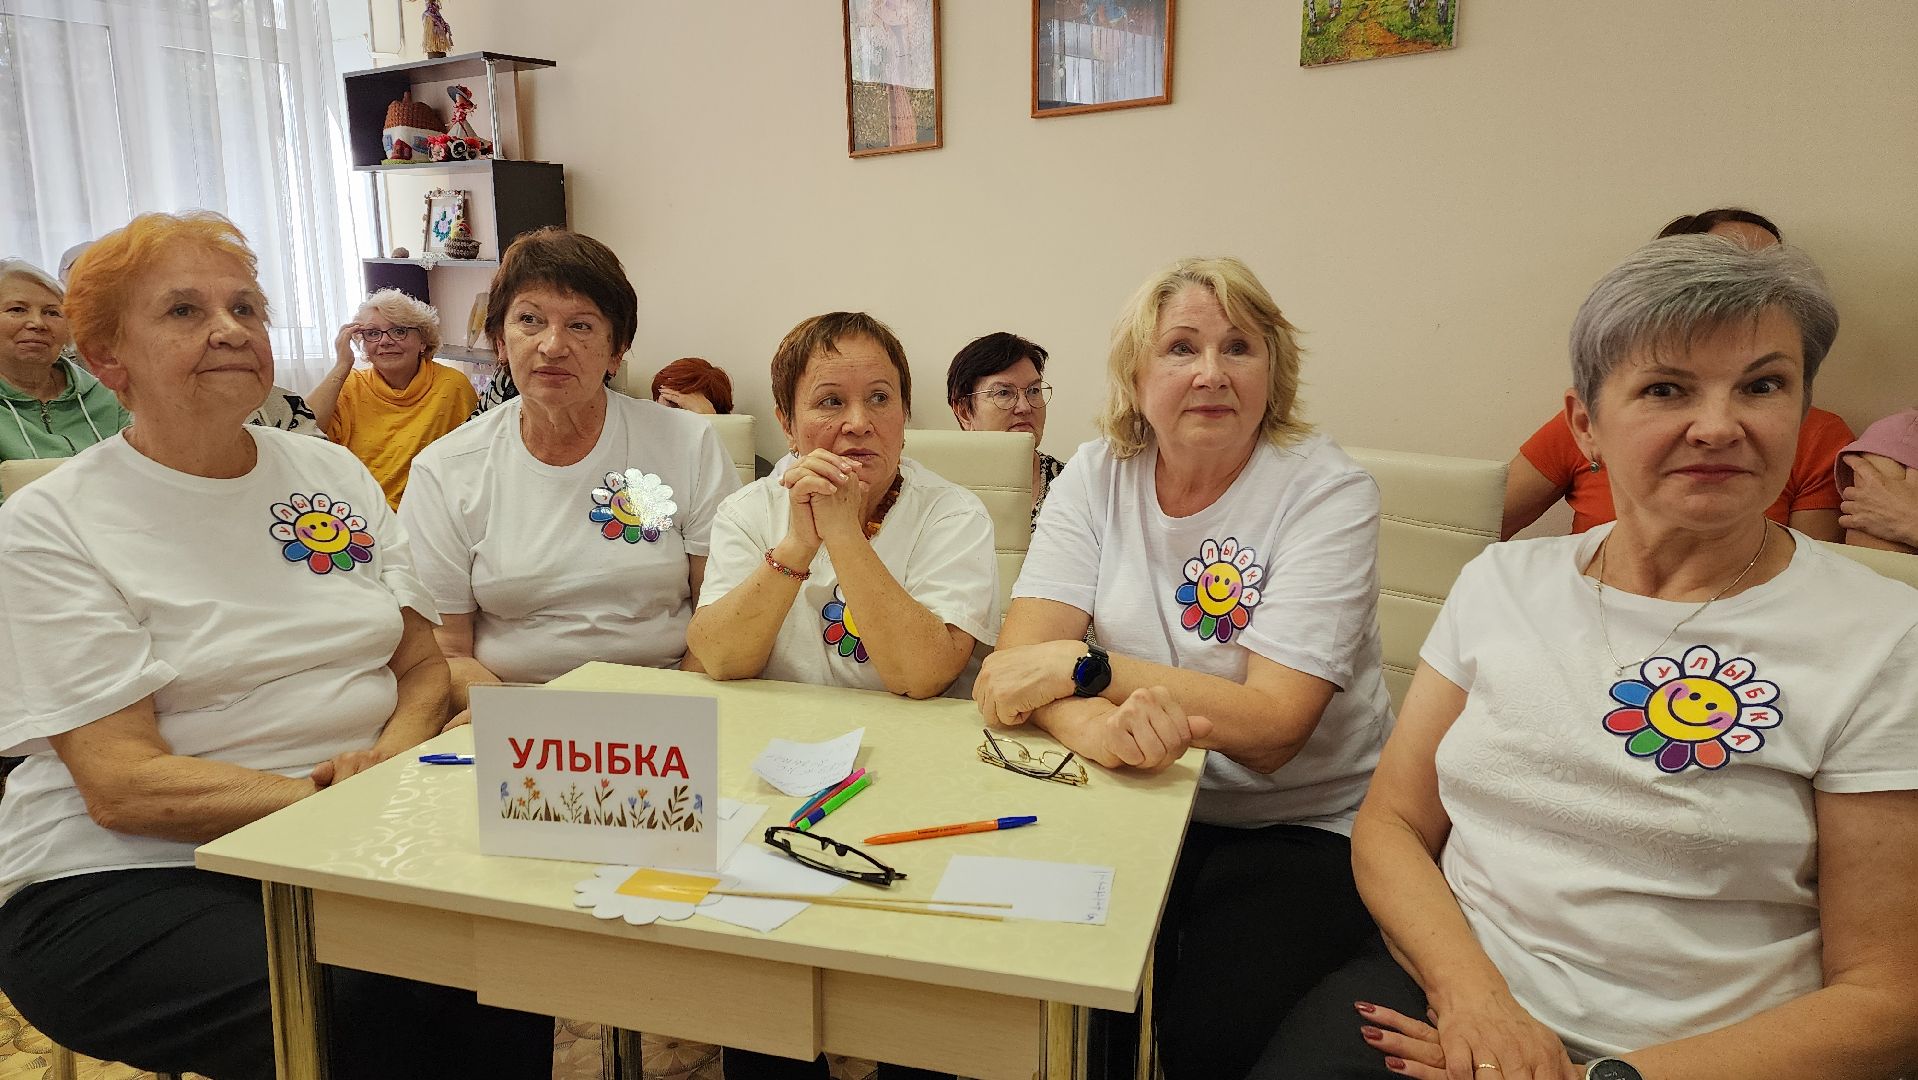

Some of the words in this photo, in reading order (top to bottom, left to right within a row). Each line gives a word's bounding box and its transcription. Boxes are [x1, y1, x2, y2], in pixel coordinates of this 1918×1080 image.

[1191, 545, 1258, 603] УЛЫБКА
[1657, 656, 1769, 746] УЛЫБКА
[508, 737, 690, 779] УЛЫБКА
